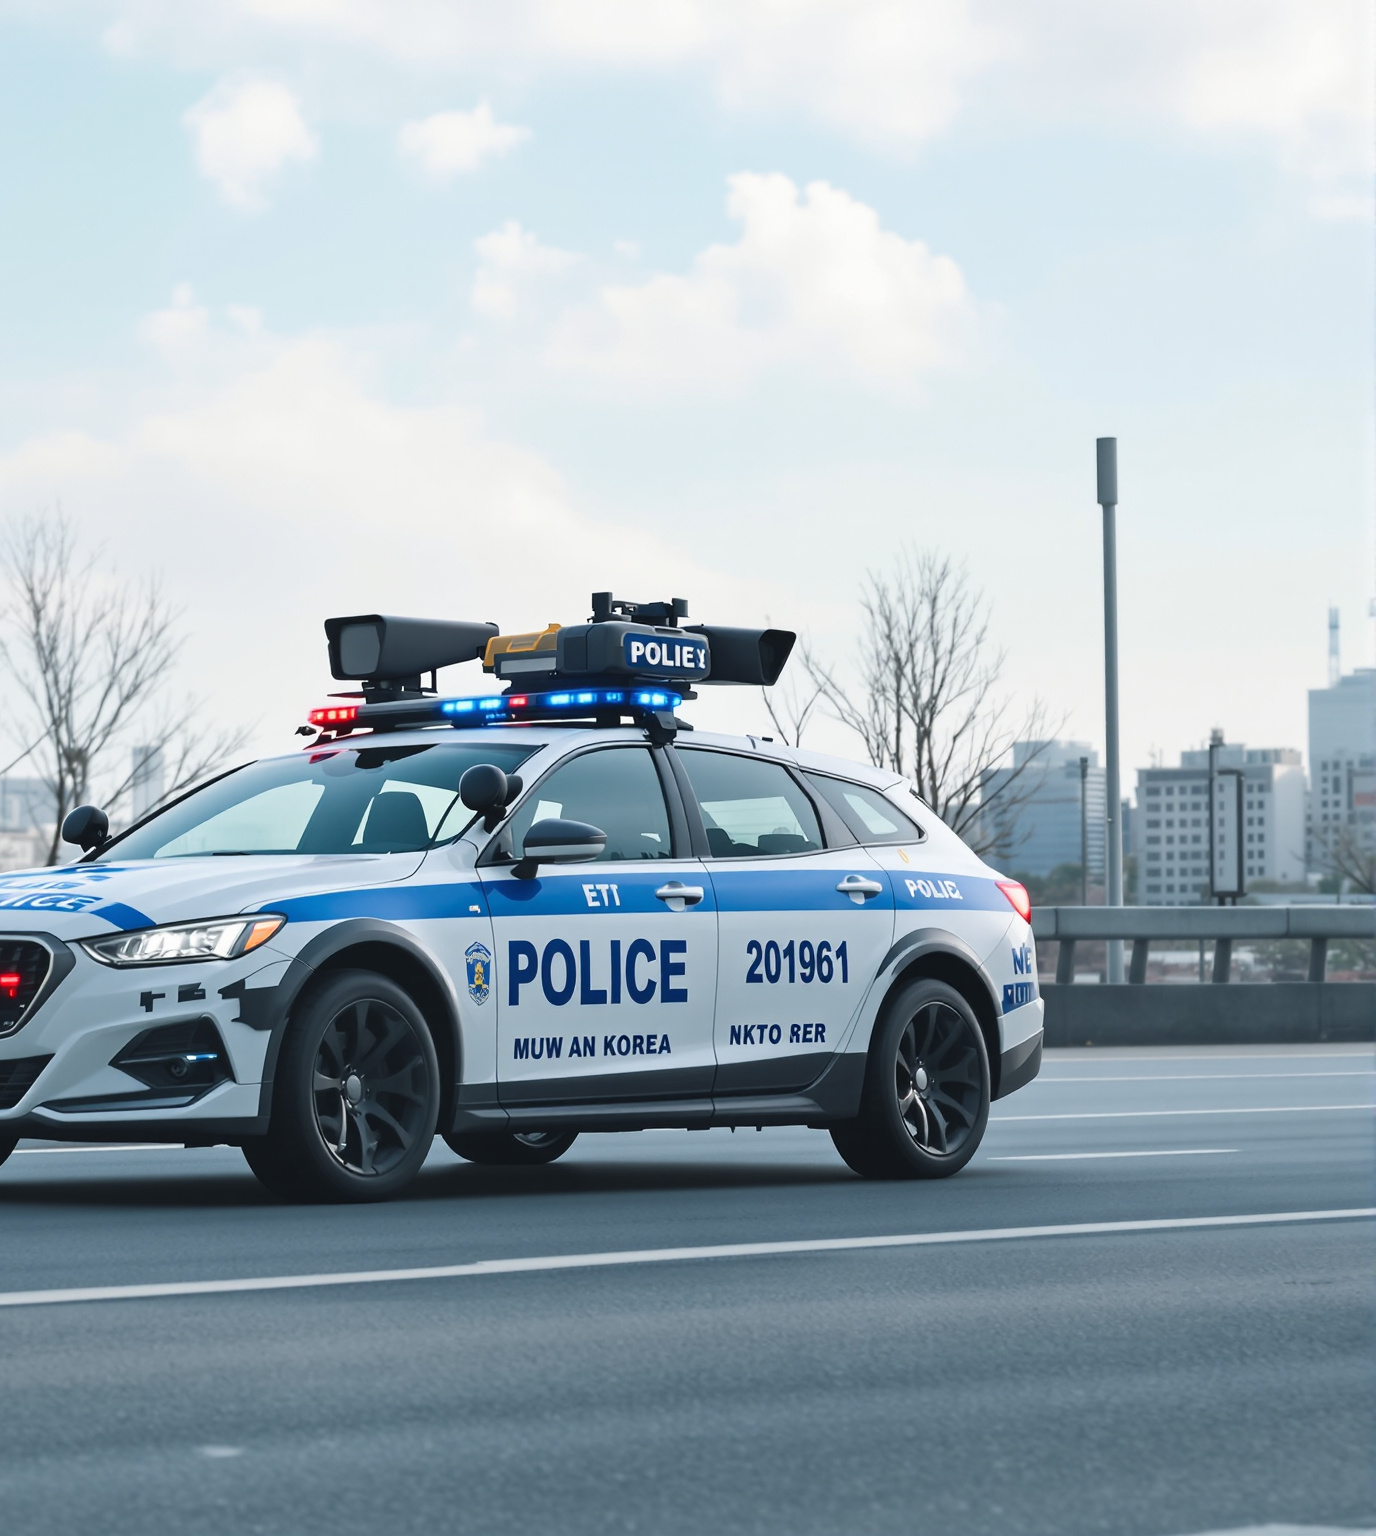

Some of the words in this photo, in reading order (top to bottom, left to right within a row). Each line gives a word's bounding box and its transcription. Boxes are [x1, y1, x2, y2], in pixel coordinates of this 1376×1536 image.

[508, 938, 688, 1007] POLICE
[745, 939, 849, 984] 201961
[513, 1036, 564, 1060] MUW
[568, 1036, 596, 1058] AN
[603, 1034, 672, 1057] KOREA
[729, 1024, 782, 1046] NKTO
